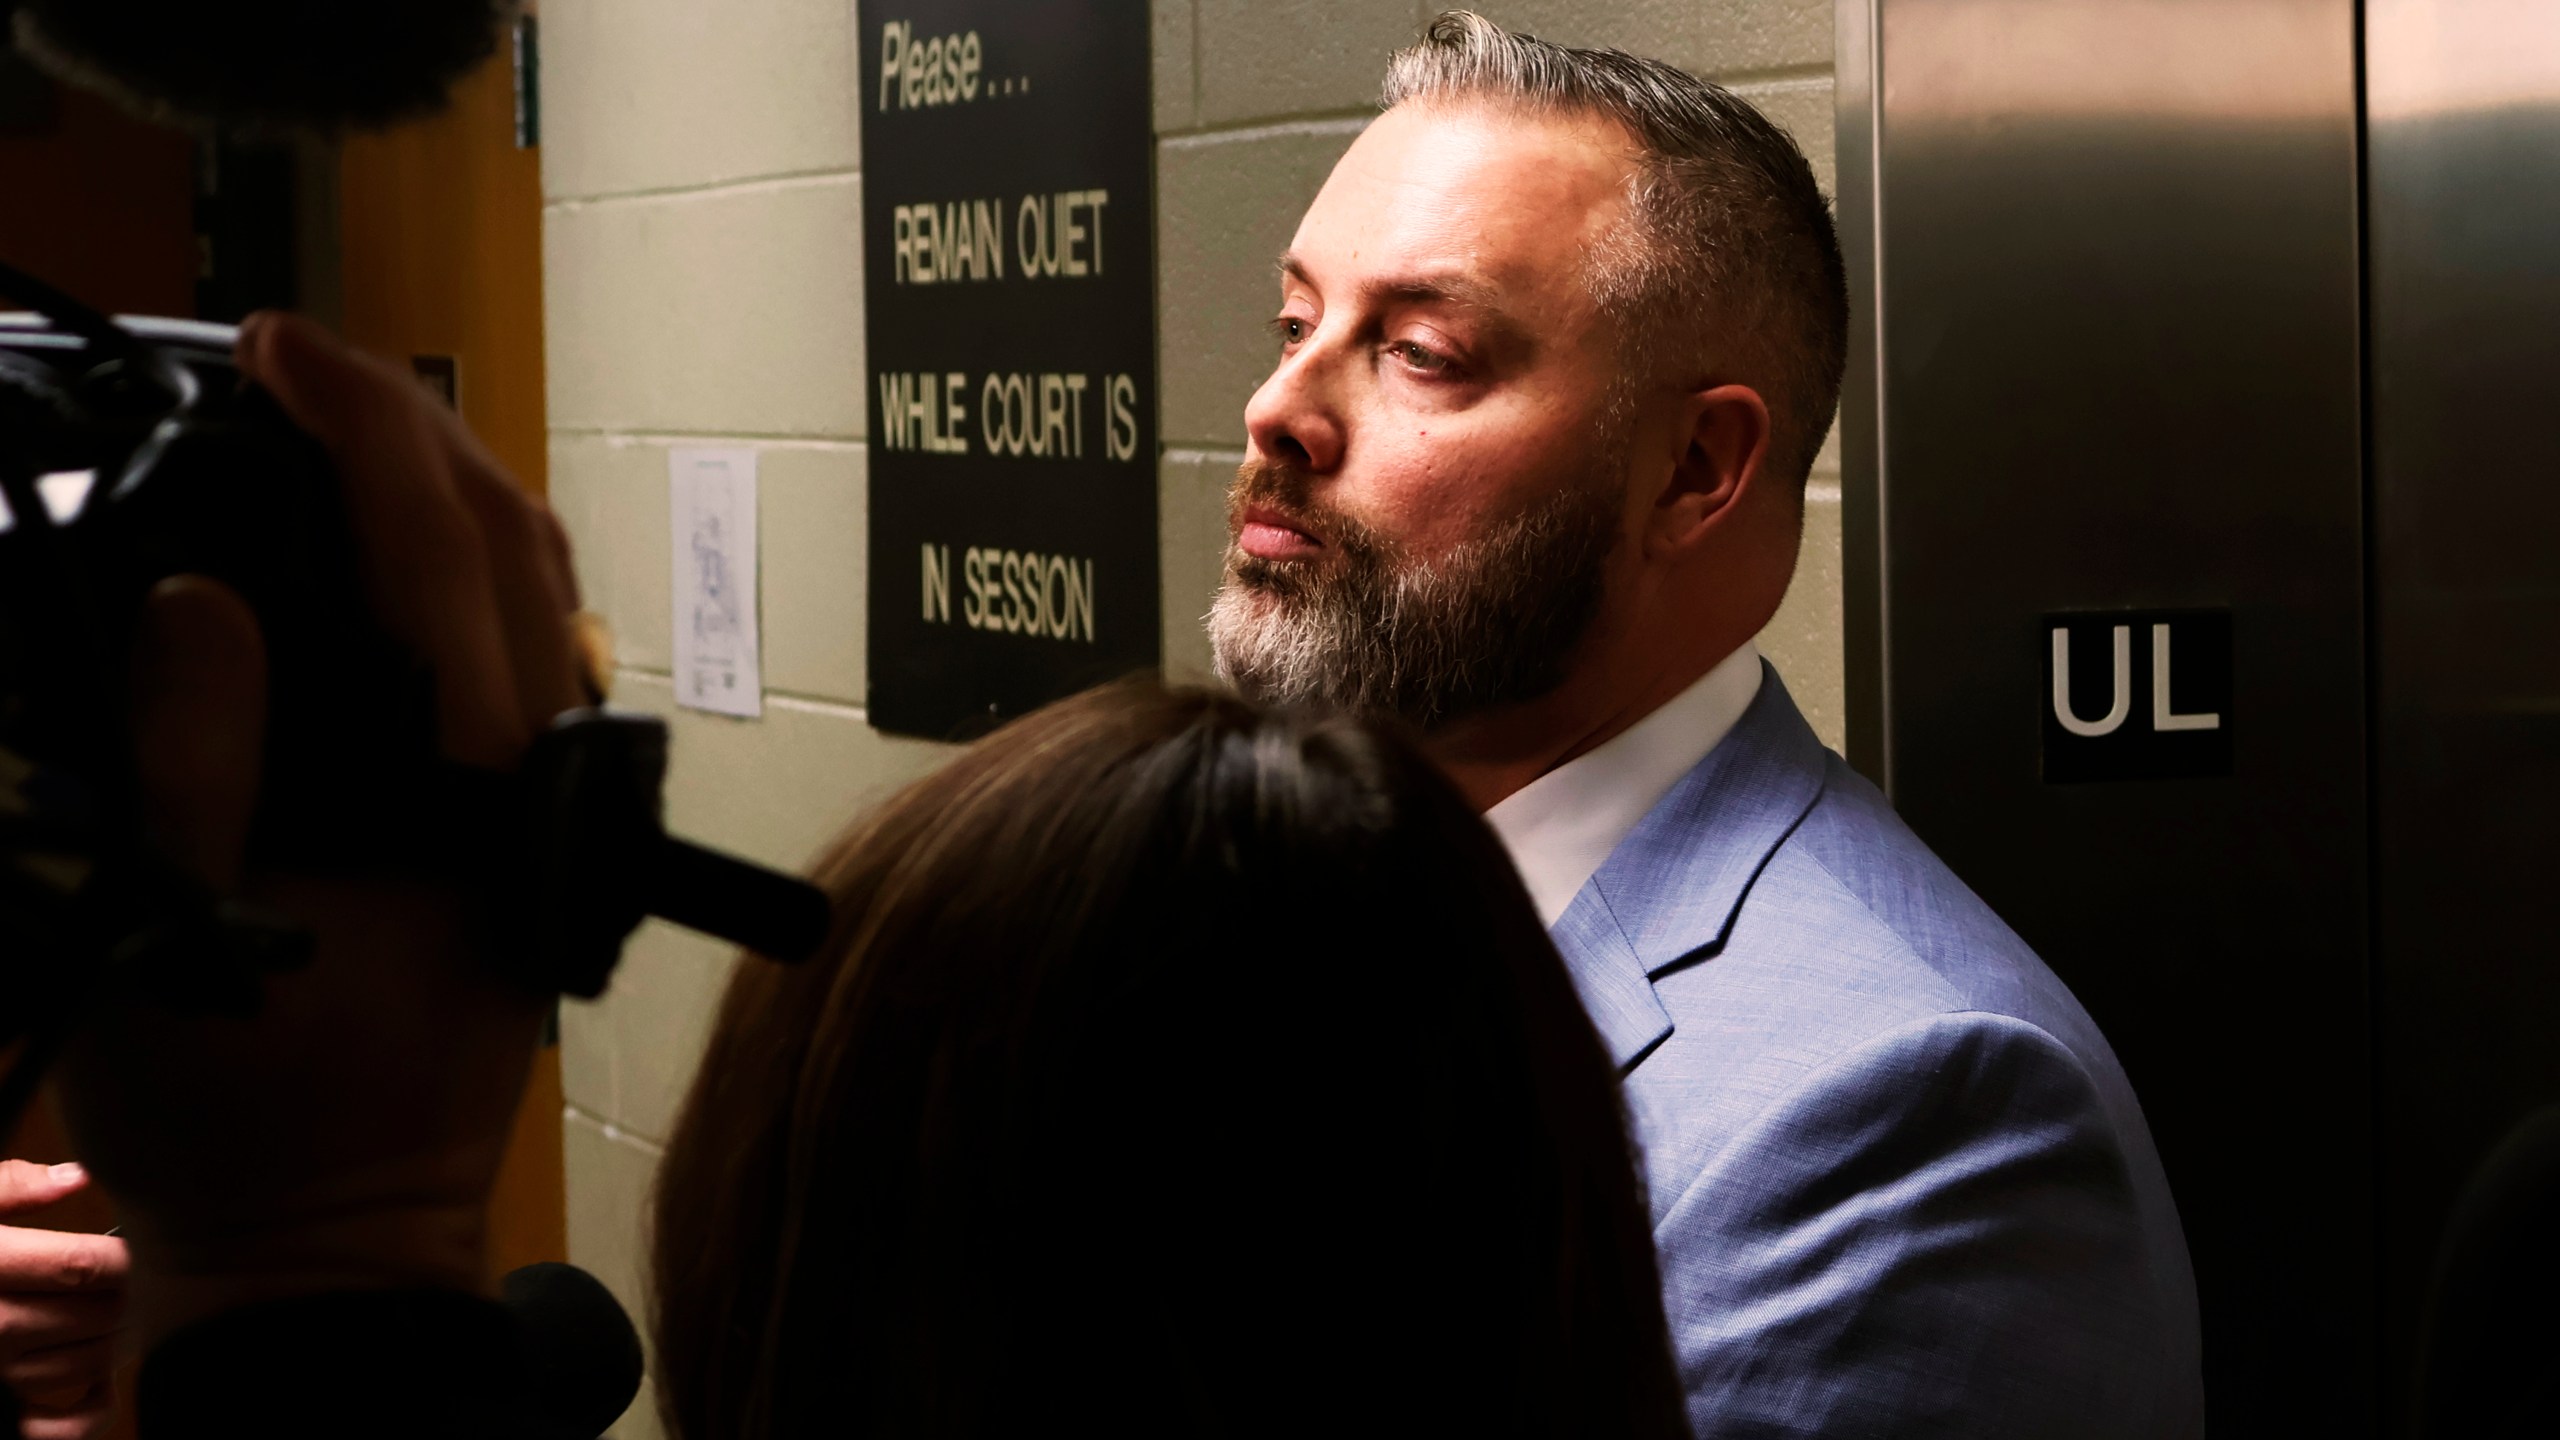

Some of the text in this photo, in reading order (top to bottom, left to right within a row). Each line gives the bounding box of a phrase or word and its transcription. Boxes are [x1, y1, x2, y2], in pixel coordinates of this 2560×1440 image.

[894, 188, 1109, 284] REMAIN QUIET
[879, 372, 1137, 461] WHILE COURT IS
[921, 543, 1094, 642] IN SESSION
[2052, 623, 2220, 737] UL
